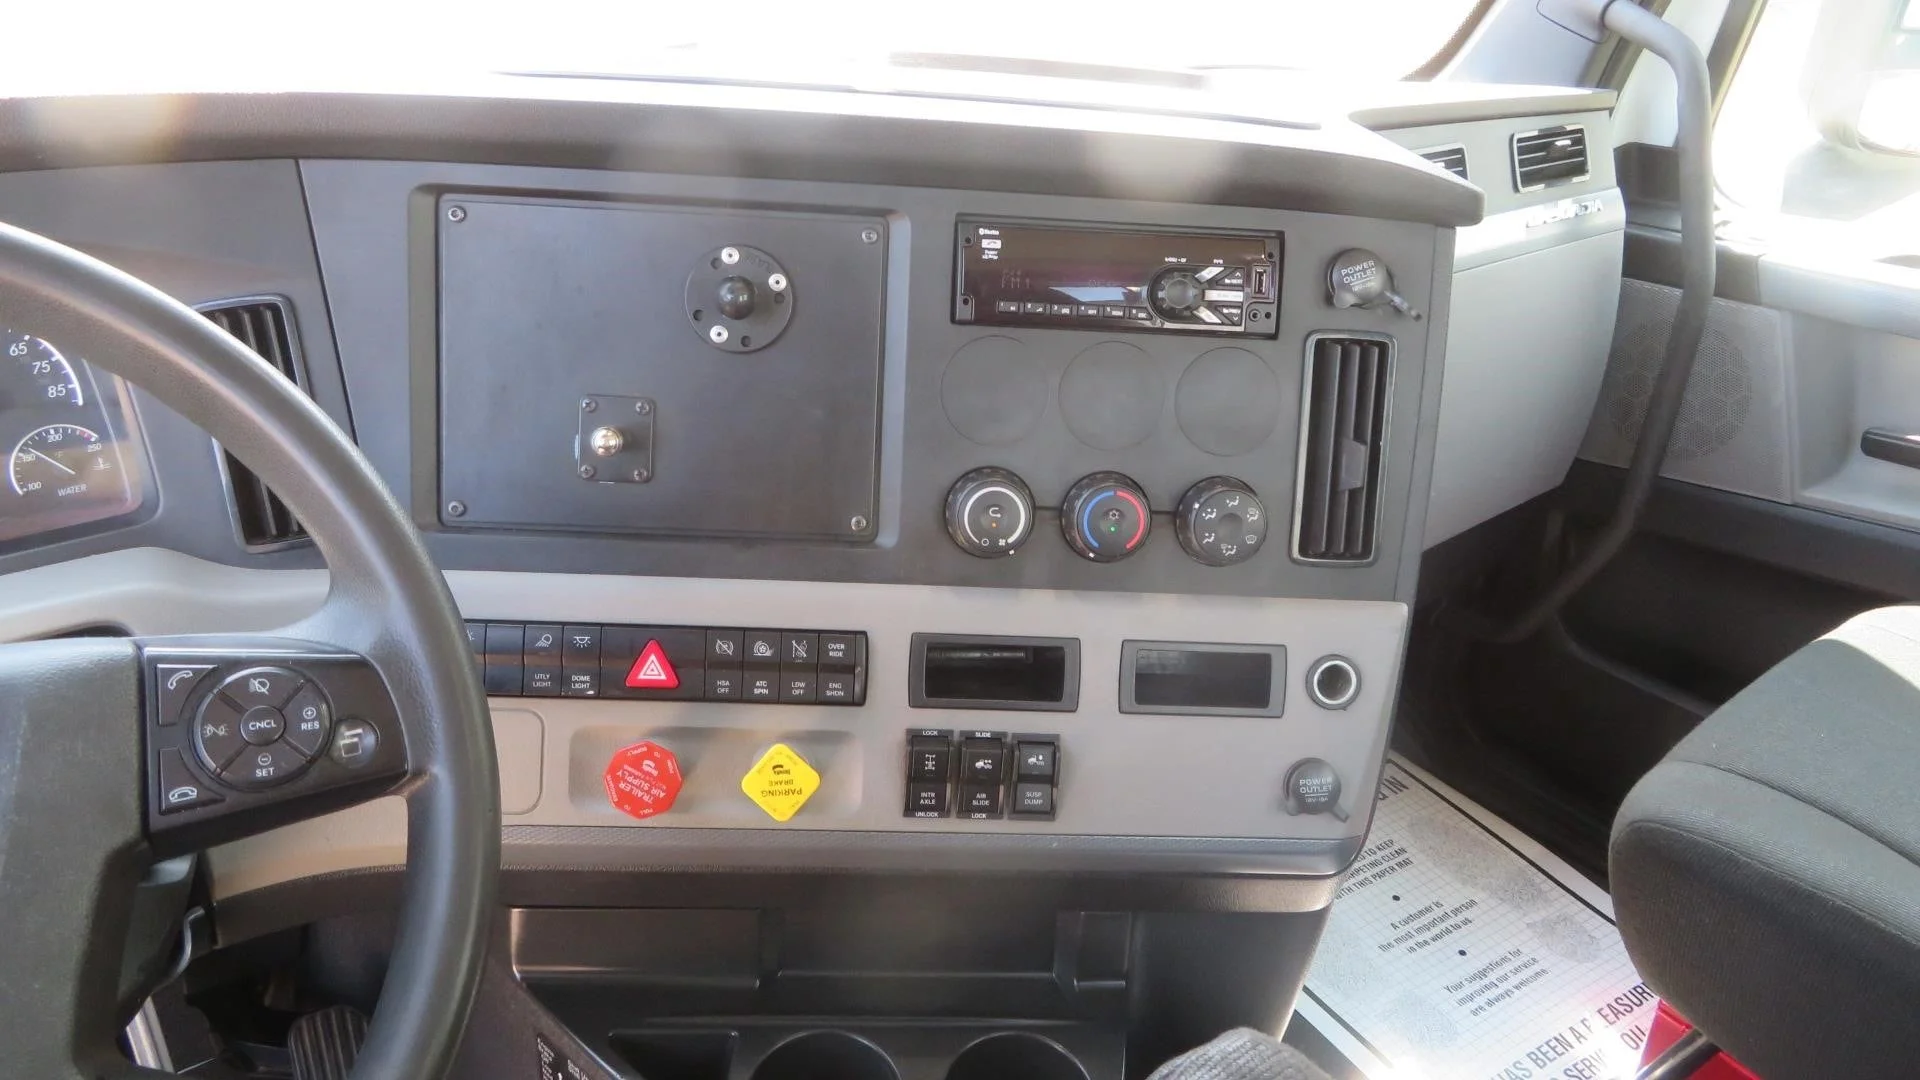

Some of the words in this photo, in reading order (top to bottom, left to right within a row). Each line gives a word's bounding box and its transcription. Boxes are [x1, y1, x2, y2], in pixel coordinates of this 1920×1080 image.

[1341, 260, 1375, 276] POWER
[1343, 268, 1376, 284] OUTLET
[9, 342, 28, 357] 65
[32, 360, 51, 374] 75
[48, 384, 66, 398] 85
[47, 434, 62, 442] 200
[28, 482, 42, 490] 100
[57, 484, 87, 497] WATER
[248, 719, 277, 731] CNCL
[301, 721, 320, 731] RES
[255, 768, 274, 777] SET
[616, 769, 650, 790] SUPPLY
[1300, 777, 1332, 785] POWER
[1300, 784, 1332, 793] OUTLET
[618, 781, 654, 804] TRAILER
[651, 786, 666, 798] AIR
[760, 787, 802, 798] PARKING
[1366, 847, 1378, 858] TO
[1375, 839, 1395, 851] KEEP
[1348, 859, 1384, 880] ARPETING
[1381, 847, 1408, 862] CLEAN
[1353, 878, 1374, 892] THIS
[1373, 865, 1397, 882] PAPER
[1395, 857, 1414, 869] MAT
[1390, 922, 1400, 930] A
[1399, 905, 1435, 926] customer
[1432, 900, 1444, 908] is
[1378, 941, 1395, 952] the
[1393, 931, 1415, 945] most
[1414, 912, 1453, 936] important
[1450, 899, 1478, 917] person
[1415, 939, 1430, 949] the
[1430, 926, 1454, 942] world
[1450, 922, 1462, 930] to
[1443, 981, 1466, 994] Your
[1464, 955, 1512, 984] suggestions
[1508, 948, 1522, 958] for
[1456, 981, 1499, 1006] improving
[1495, 973, 1510, 984] our
[1510, 957, 1539, 975] service
[1470, 1005, 1487, 1016] are
[1485, 988, 1515, 1008] always
[1526, 1032, 1575, 1069] BEEN
[1568, 1026, 1588, 1044] A
[1580, 982, 1655, 1034] PEASUR
